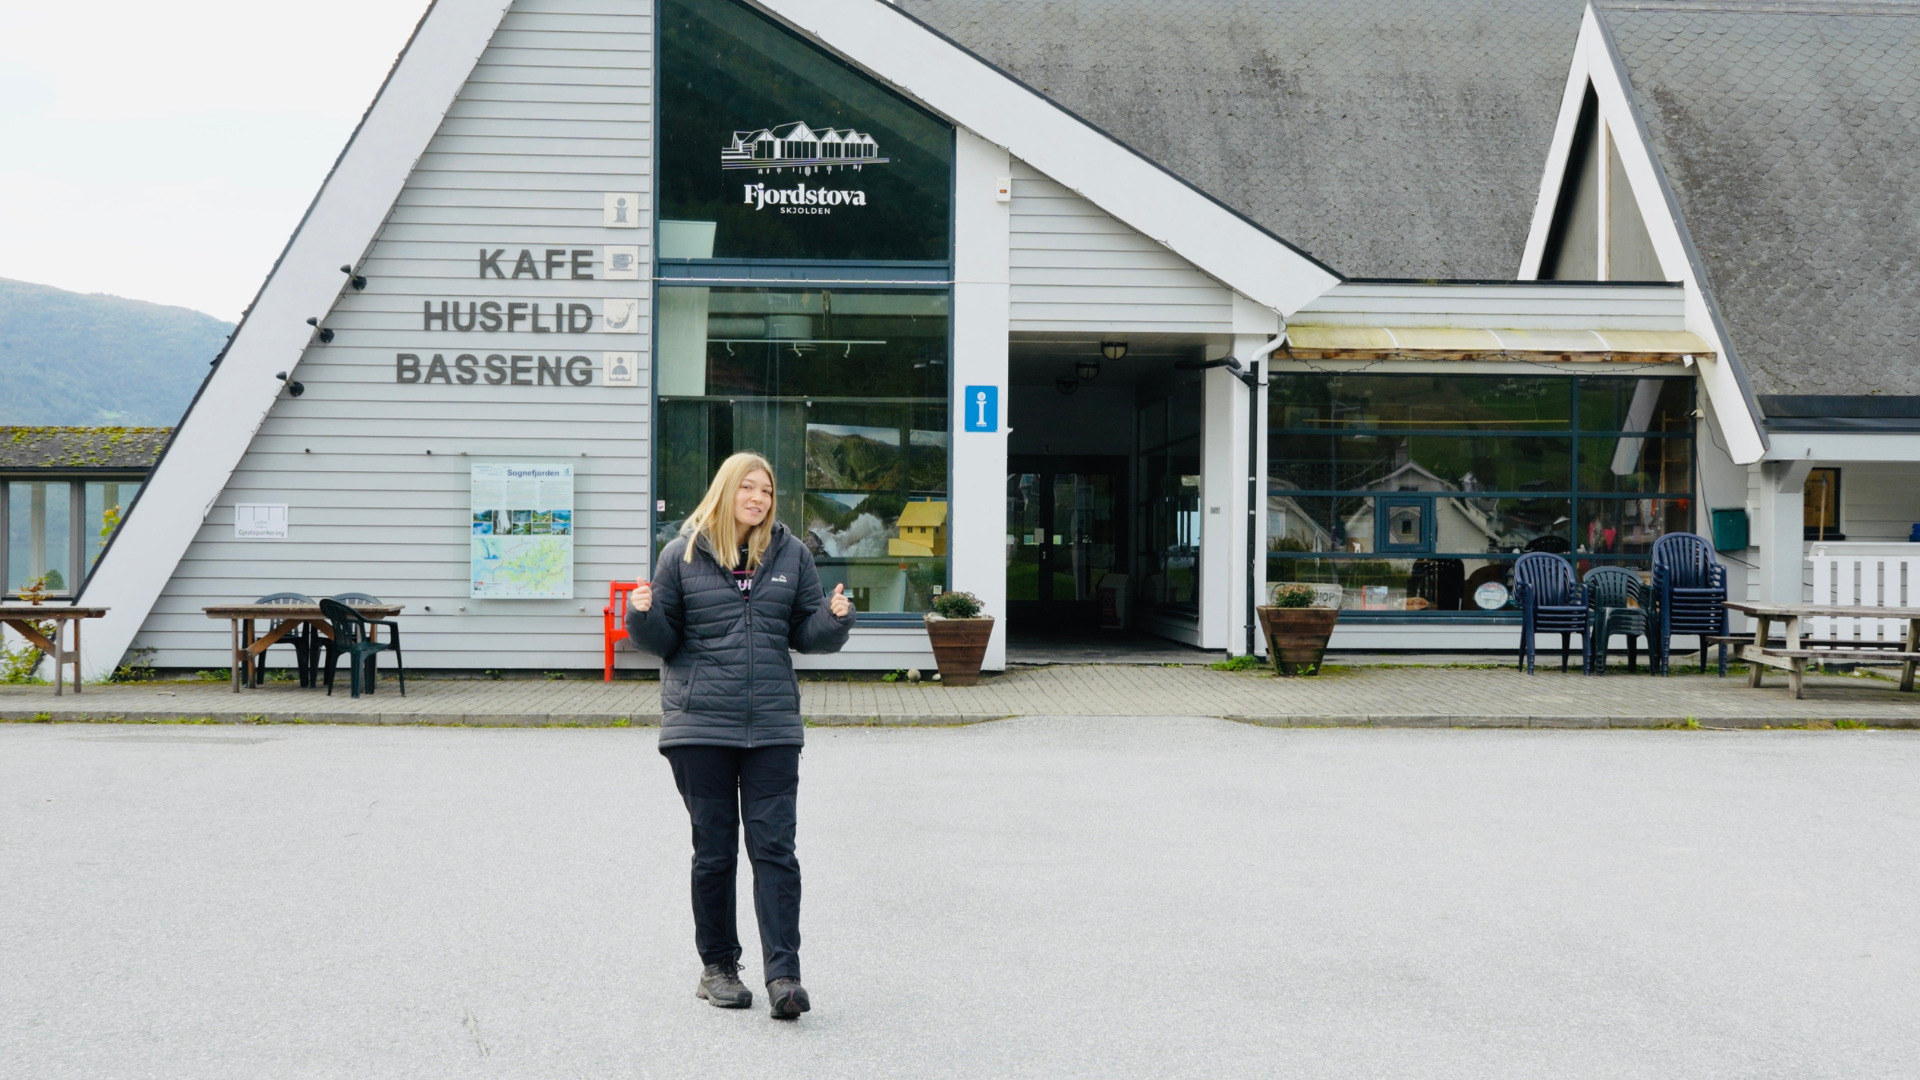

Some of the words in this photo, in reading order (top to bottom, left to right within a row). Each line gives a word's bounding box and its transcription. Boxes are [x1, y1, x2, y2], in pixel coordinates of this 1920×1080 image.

[743, 182, 868, 211] Fjordstova
[780, 206, 832, 215] SKJOLDEN
[479, 248, 594, 280] KAFE
[424, 300, 593, 333] HUSFLID
[396, 353, 593, 387] BASSENG
[506, 468, 560, 478] Sognefjorden
[1314, 591, 1336, 602] HOP
